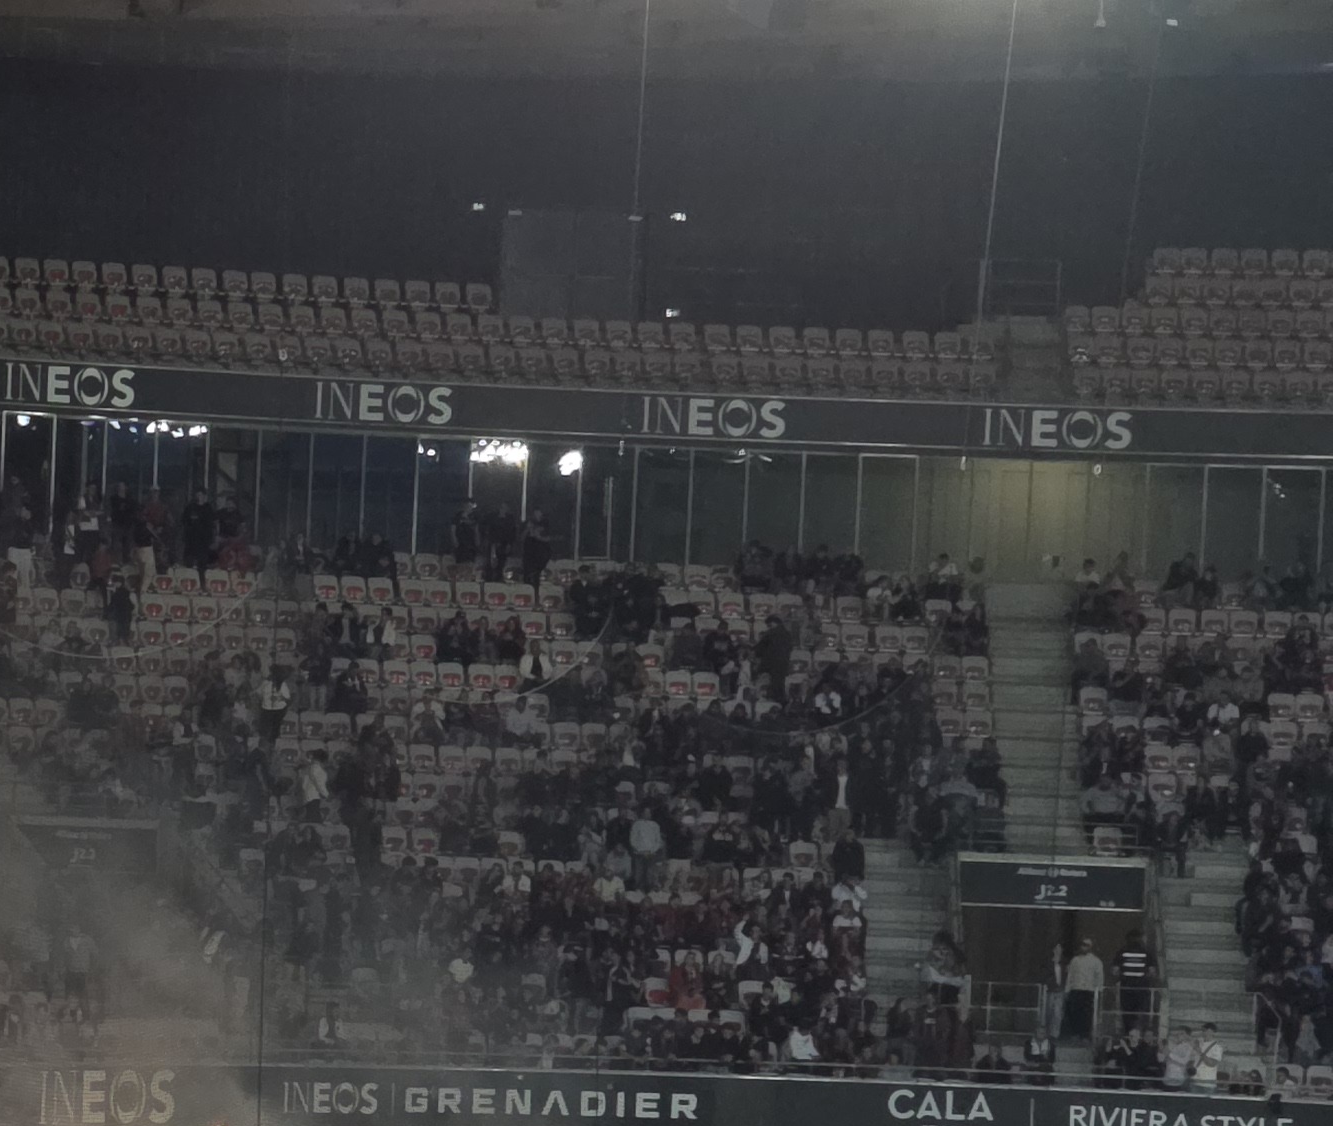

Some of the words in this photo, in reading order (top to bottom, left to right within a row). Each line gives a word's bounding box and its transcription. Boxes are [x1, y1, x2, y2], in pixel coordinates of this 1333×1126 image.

[5, 361, 135, 408] INEOS
[314, 381, 452, 426] INEOS
[640, 396, 786, 440] INEOS
[982, 408, 1133, 451] INEOS
[39, 1069, 176, 1125] INEOS
[283, 1081, 379, 1115] INEOS
[404, 1085, 699, 1120] GRENADIER
[887, 1089, 994, 1121] CALA
